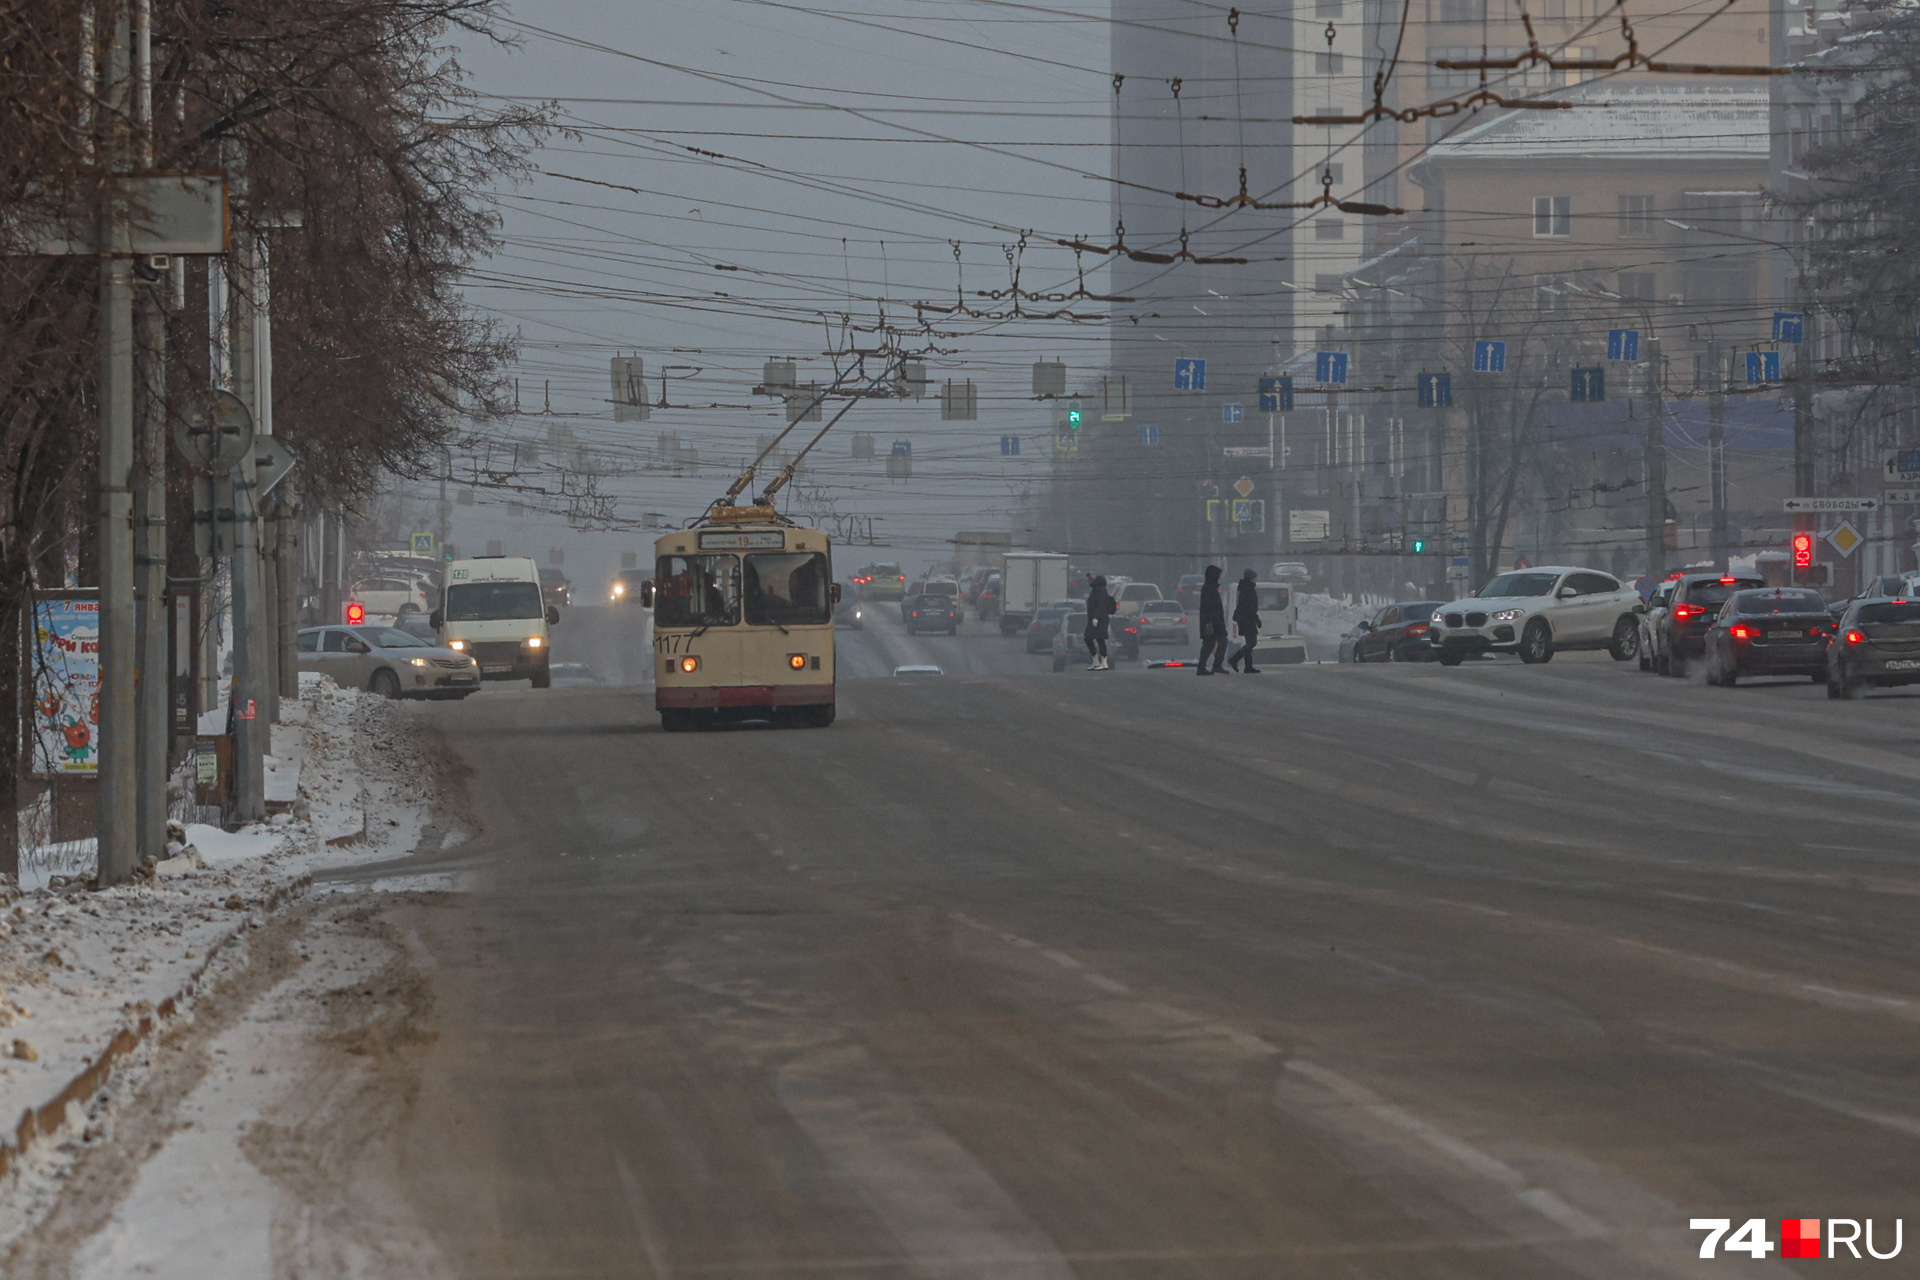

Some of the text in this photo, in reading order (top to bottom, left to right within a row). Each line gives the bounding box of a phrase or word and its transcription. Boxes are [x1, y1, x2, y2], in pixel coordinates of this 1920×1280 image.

[1812, 501, 1859, 509] СВОБОДЫ
[738, 537, 750, 547] 19
[454, 570, 468, 580] 128
[64, 601, 71, 611] 7
[655, 634, 694, 654] 1177
